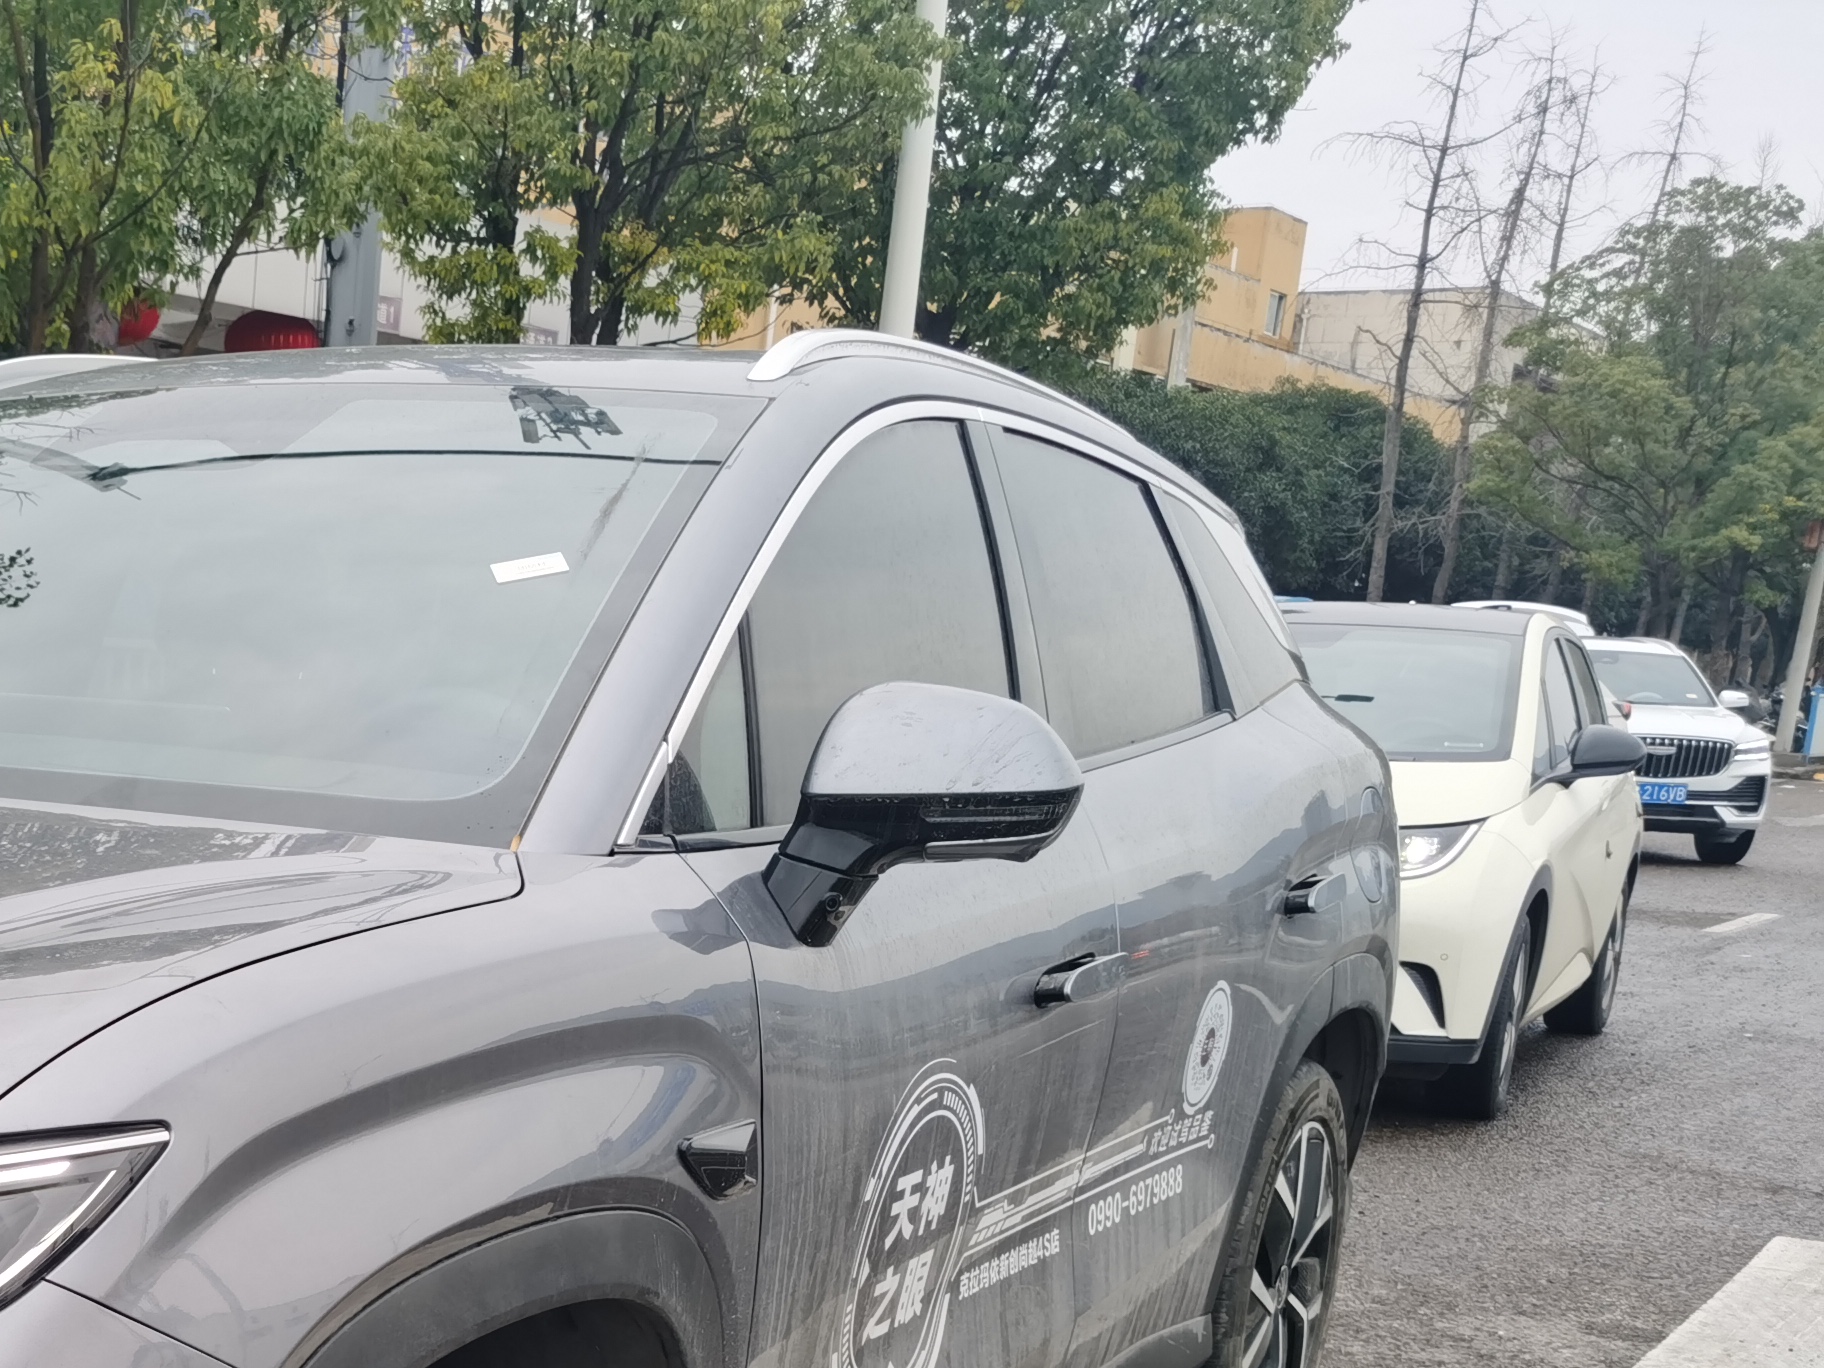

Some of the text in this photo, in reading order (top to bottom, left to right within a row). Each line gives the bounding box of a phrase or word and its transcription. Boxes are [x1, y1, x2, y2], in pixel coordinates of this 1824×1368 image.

[885, 1155, 955, 1251] 天神
[1088, 1164, 1183, 1236] 0990-6979888
[862, 1248, 935, 1346] 之眼
